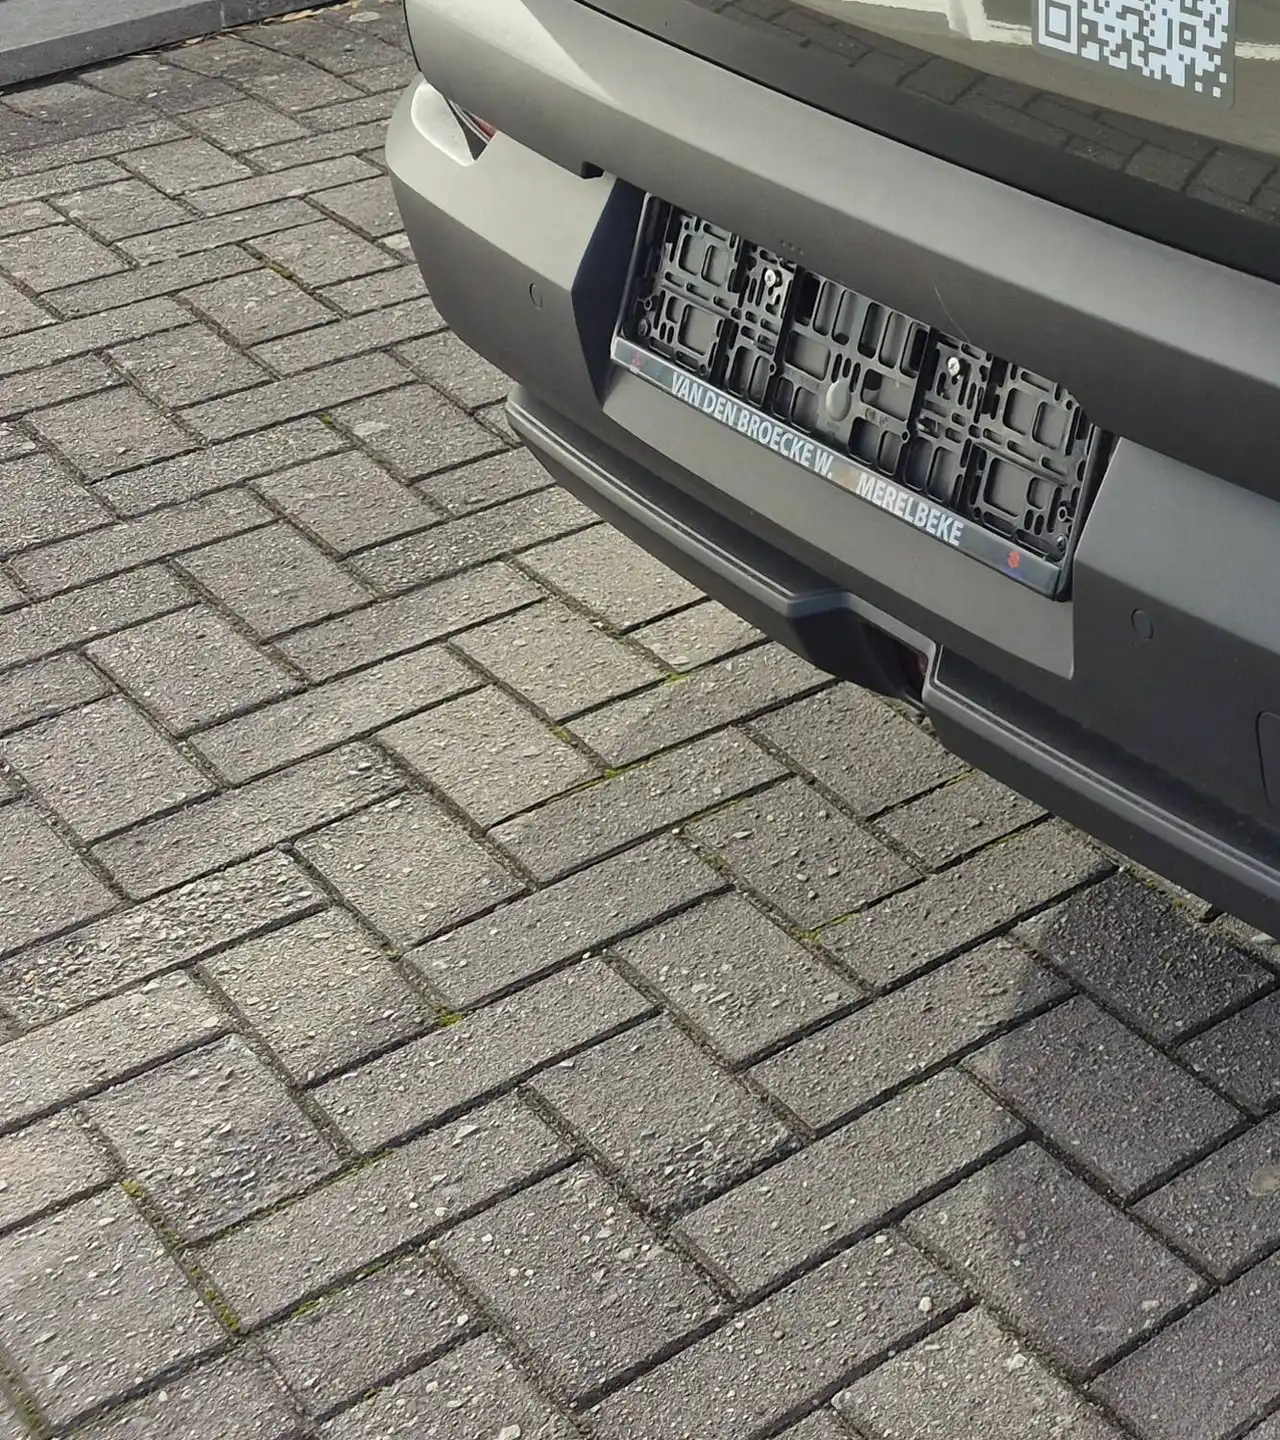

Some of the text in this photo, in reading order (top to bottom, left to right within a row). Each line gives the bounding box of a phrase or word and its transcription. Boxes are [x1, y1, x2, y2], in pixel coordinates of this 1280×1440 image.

[670, 371, 965, 547] VAN DEN BROECKE W. MERELBEKE
